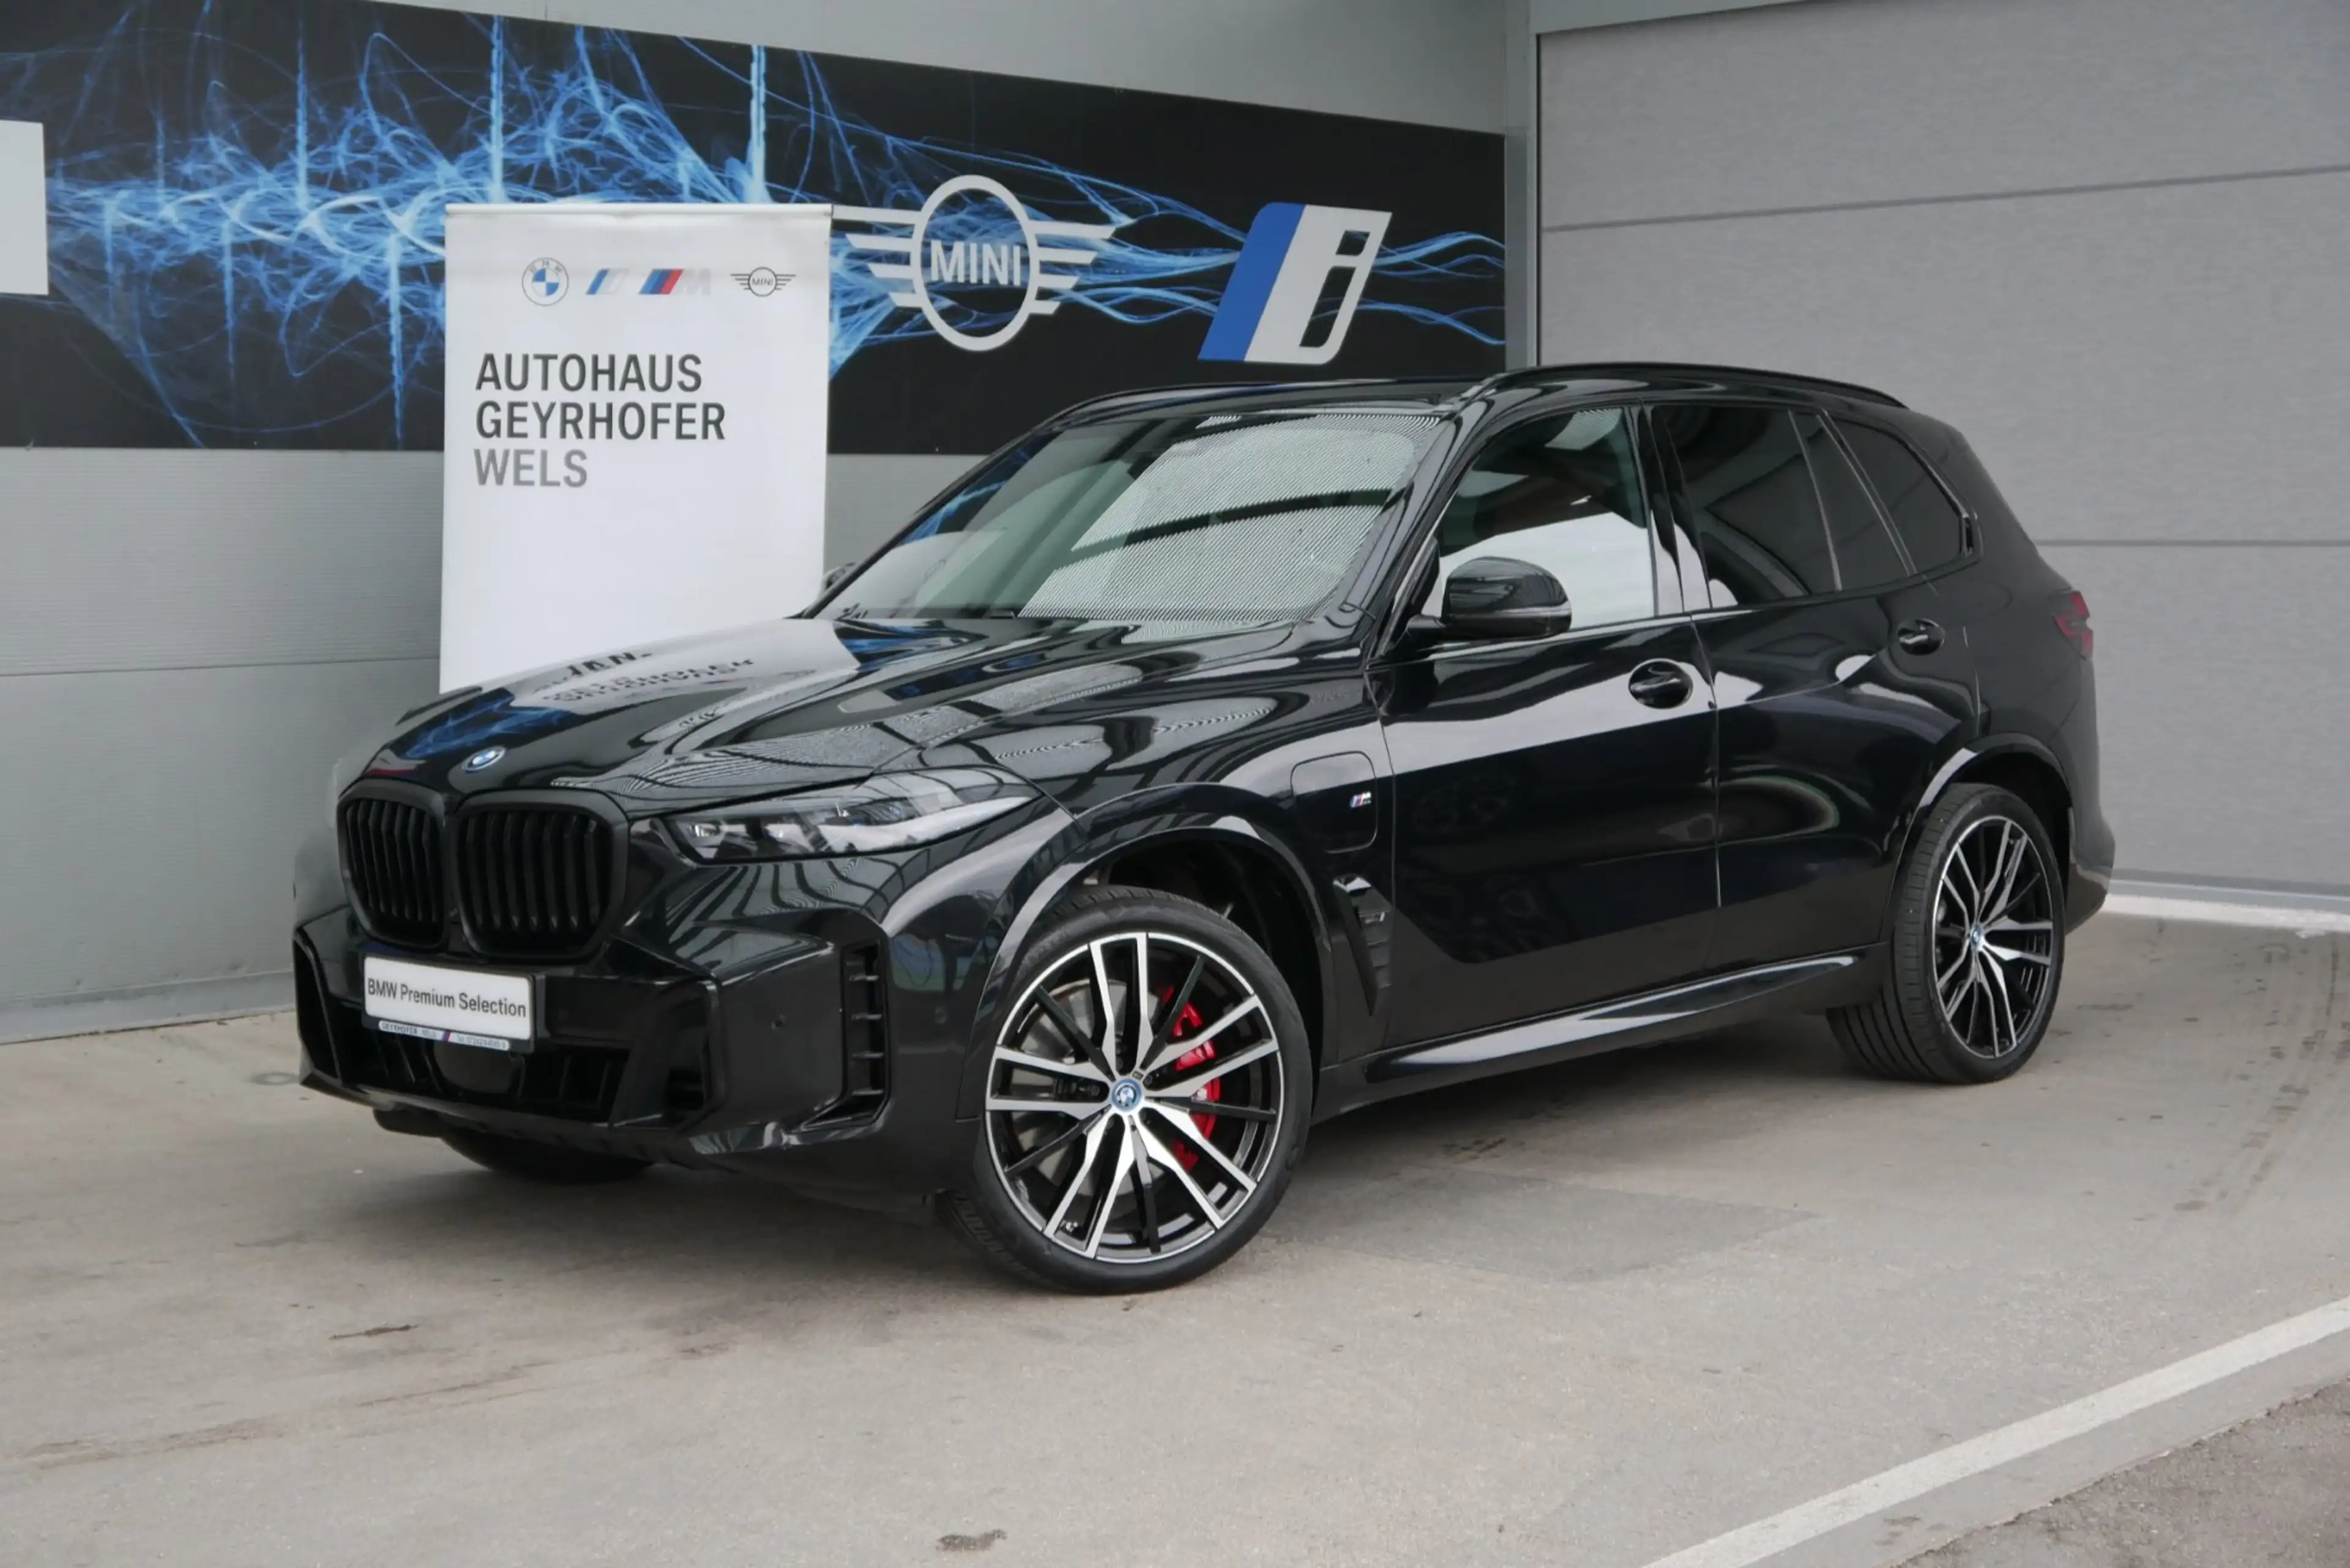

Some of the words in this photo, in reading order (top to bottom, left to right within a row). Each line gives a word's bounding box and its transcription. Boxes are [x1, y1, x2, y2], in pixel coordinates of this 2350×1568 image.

[752, 277, 774, 287] MINI
[930, 239, 1021, 286] MINI
[475, 353, 703, 393] AUTOHAUS
[476, 400, 726, 441] GEYRHOFER
[474, 448, 588, 488] WELS
[368, 977, 397, 1000] BMW
[400, 984, 455, 1009] Premium
[459, 992, 526, 1018] Selection
